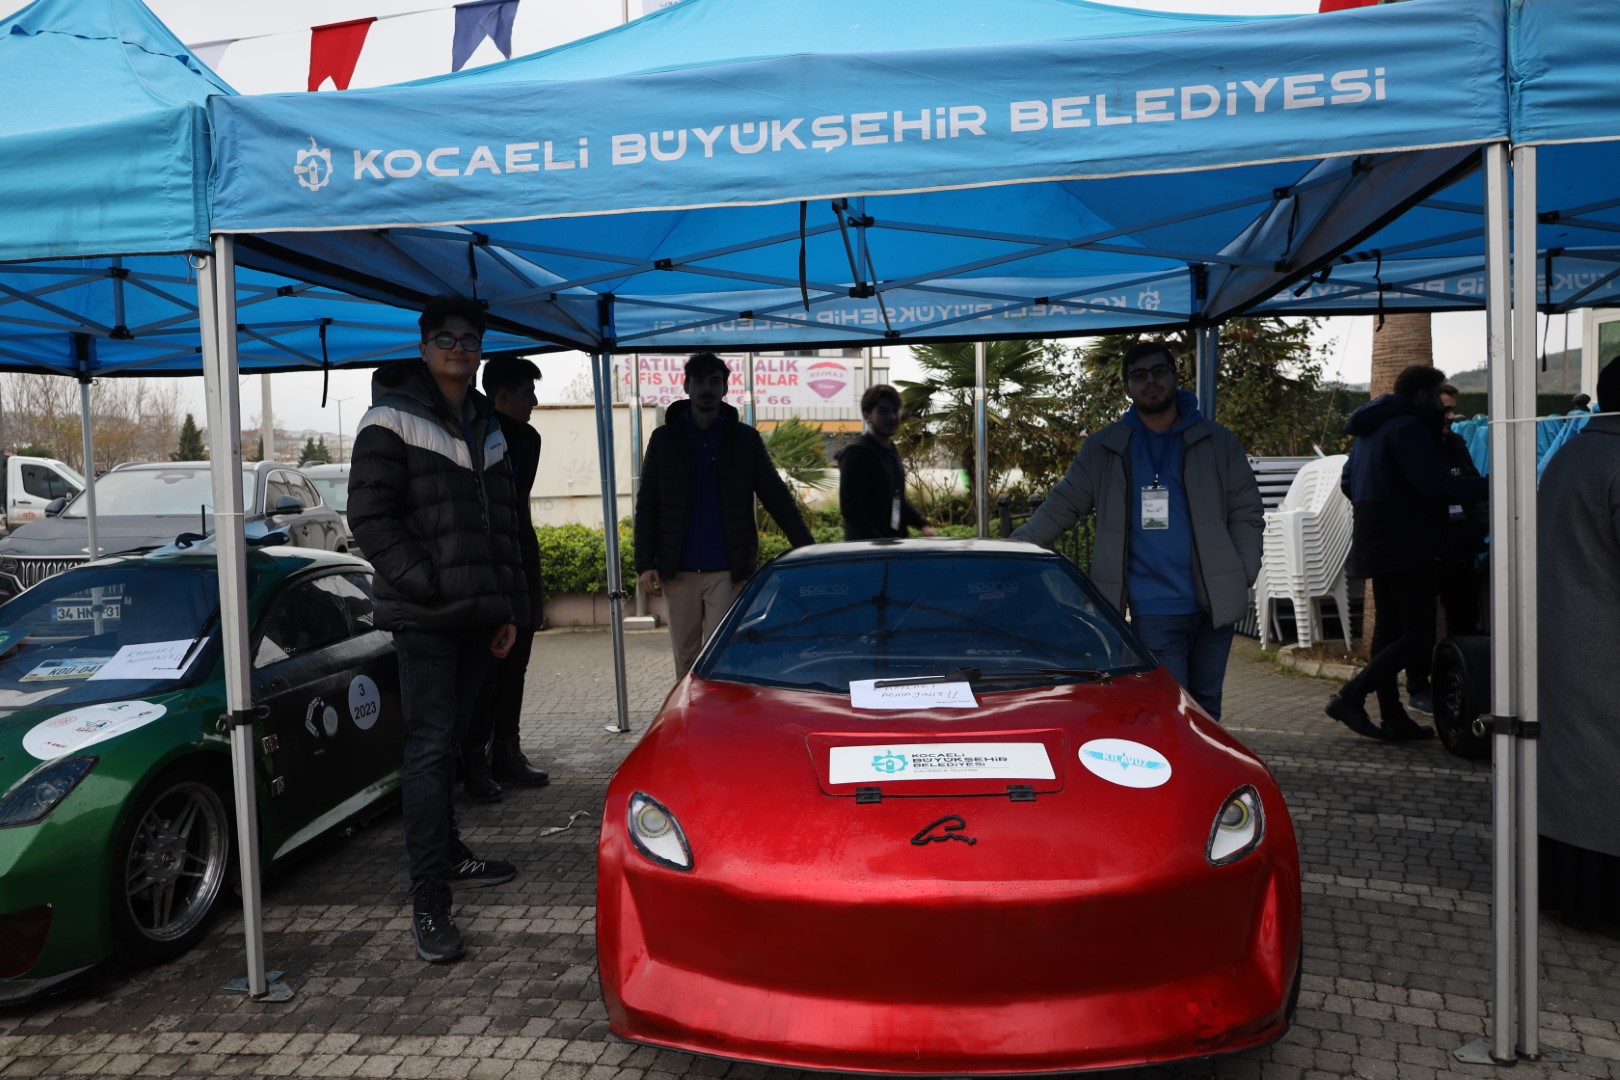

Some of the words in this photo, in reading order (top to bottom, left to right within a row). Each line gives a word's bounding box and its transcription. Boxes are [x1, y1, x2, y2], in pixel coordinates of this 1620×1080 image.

[767, 395, 792, 405] 66
[799, 583, 849, 597] sparco
[967, 582, 1020, 594] sparco
[58, 607, 73, 620] 34
[358, 683, 366, 697] 3
[354, 701, 377, 720] 2023
[1102, 752, 1148, 766] KILAVUZ
